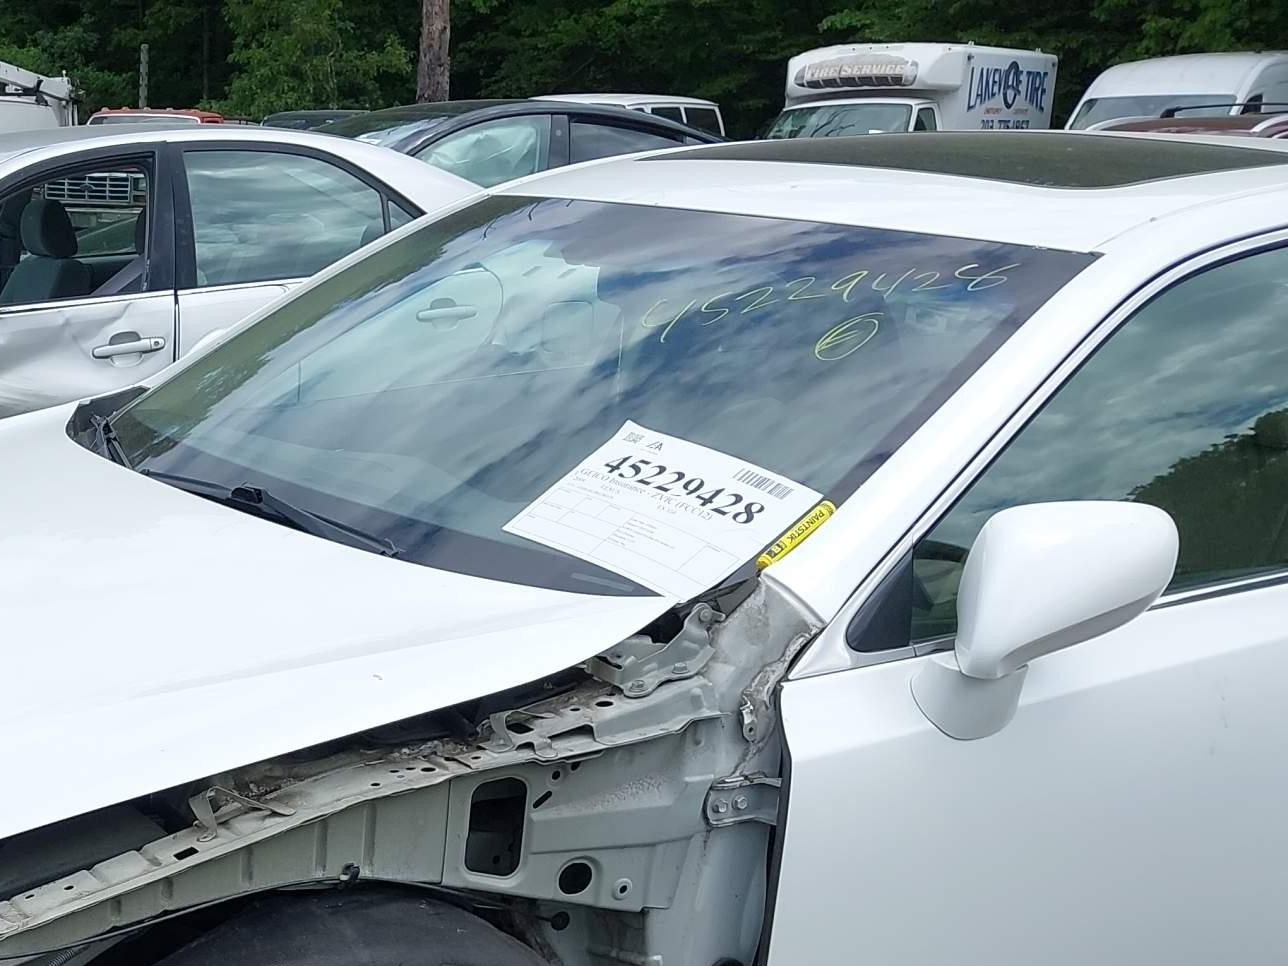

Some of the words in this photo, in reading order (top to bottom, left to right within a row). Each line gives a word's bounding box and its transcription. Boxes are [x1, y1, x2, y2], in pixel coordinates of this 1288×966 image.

[840, 63, 905, 76] SERVICE
[1024, 70, 1049, 112] TIRE
[642, 263, 1020, 343] 45229428
[604, 455, 765, 524] 45229428
[787, 509, 825, 544] PAINTSTIK
